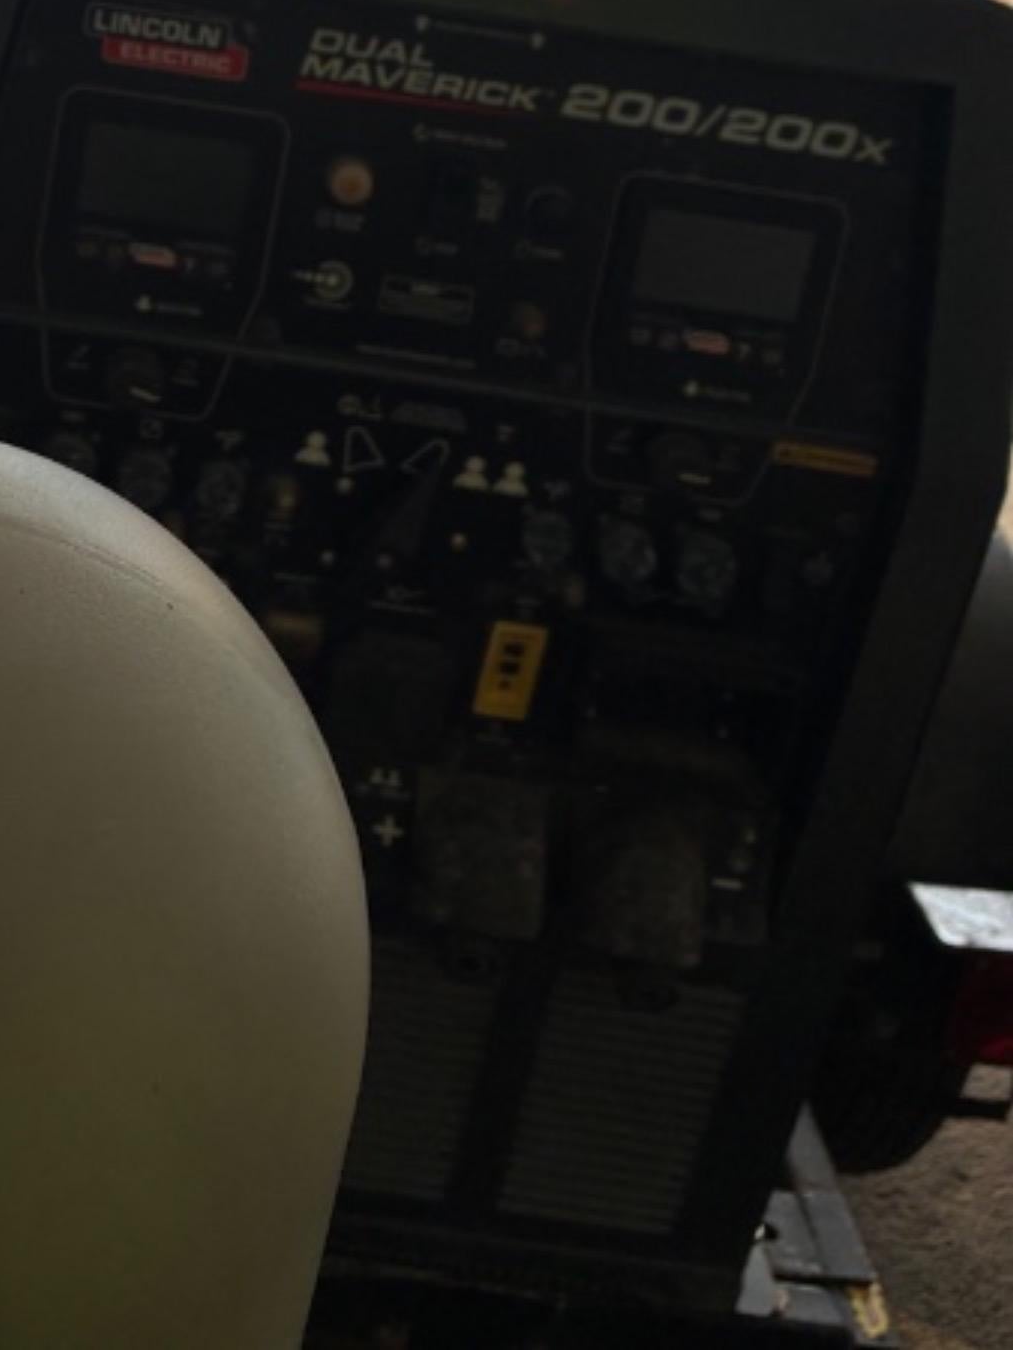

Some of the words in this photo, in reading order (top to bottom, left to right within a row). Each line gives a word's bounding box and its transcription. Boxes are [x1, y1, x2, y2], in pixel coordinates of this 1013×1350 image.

[93, 7, 225, 48] LINCOLN
[309, 25, 435, 68] DUAL
[119, 44, 234, 74] ELECTRIC
[300, 53, 539, 112] MAVERICK
